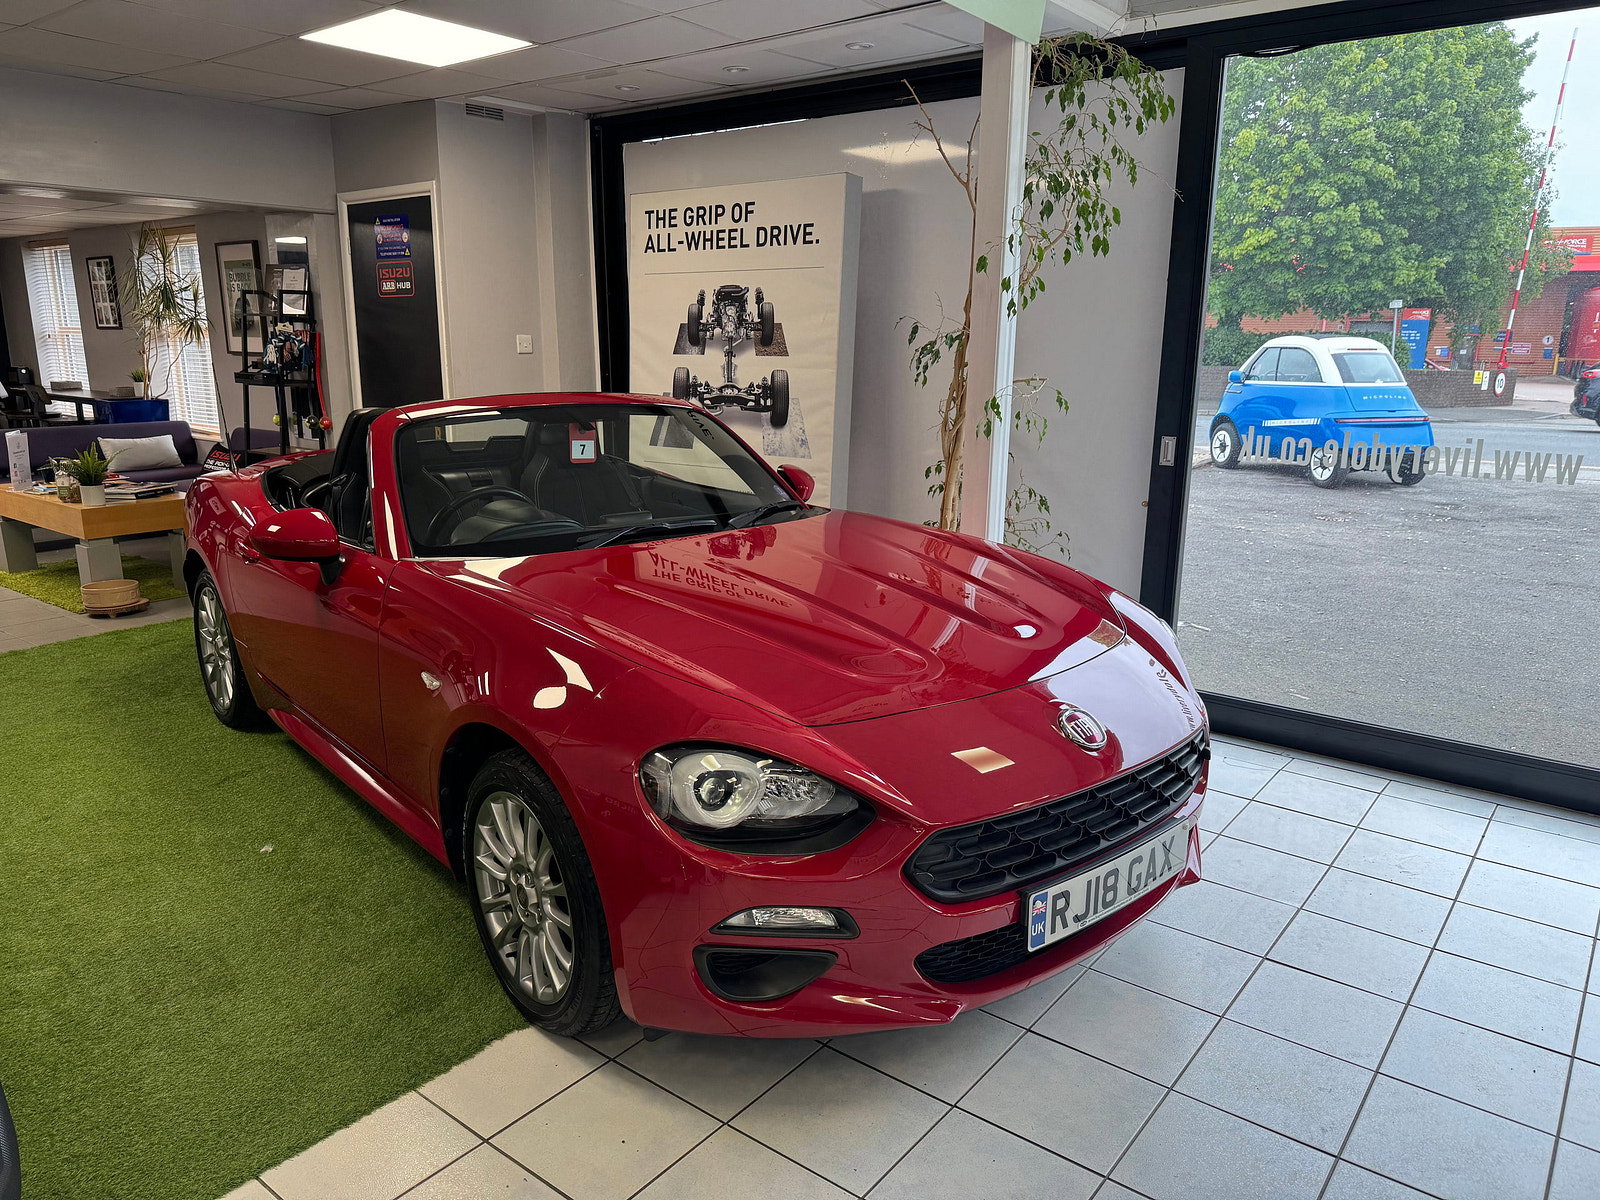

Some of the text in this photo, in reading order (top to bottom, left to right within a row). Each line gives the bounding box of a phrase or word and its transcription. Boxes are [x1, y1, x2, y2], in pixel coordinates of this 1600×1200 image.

[645, 201, 755, 230] THE GRIP OF
[644, 223, 820, 253] ALL-WHEEL DRIVE.
[379, 268, 411, 279] ISUZU
[396, 281, 411, 289] HUB
[1496, 377, 1505, 389] 10
[579, 444, 586, 455] 7
[1070, 717, 1099, 739] FIAT
[1050, 867, 1120, 935] RJ18
[1126, 835, 1176, 897] GAX
[1031, 921, 1045, 936] UK
